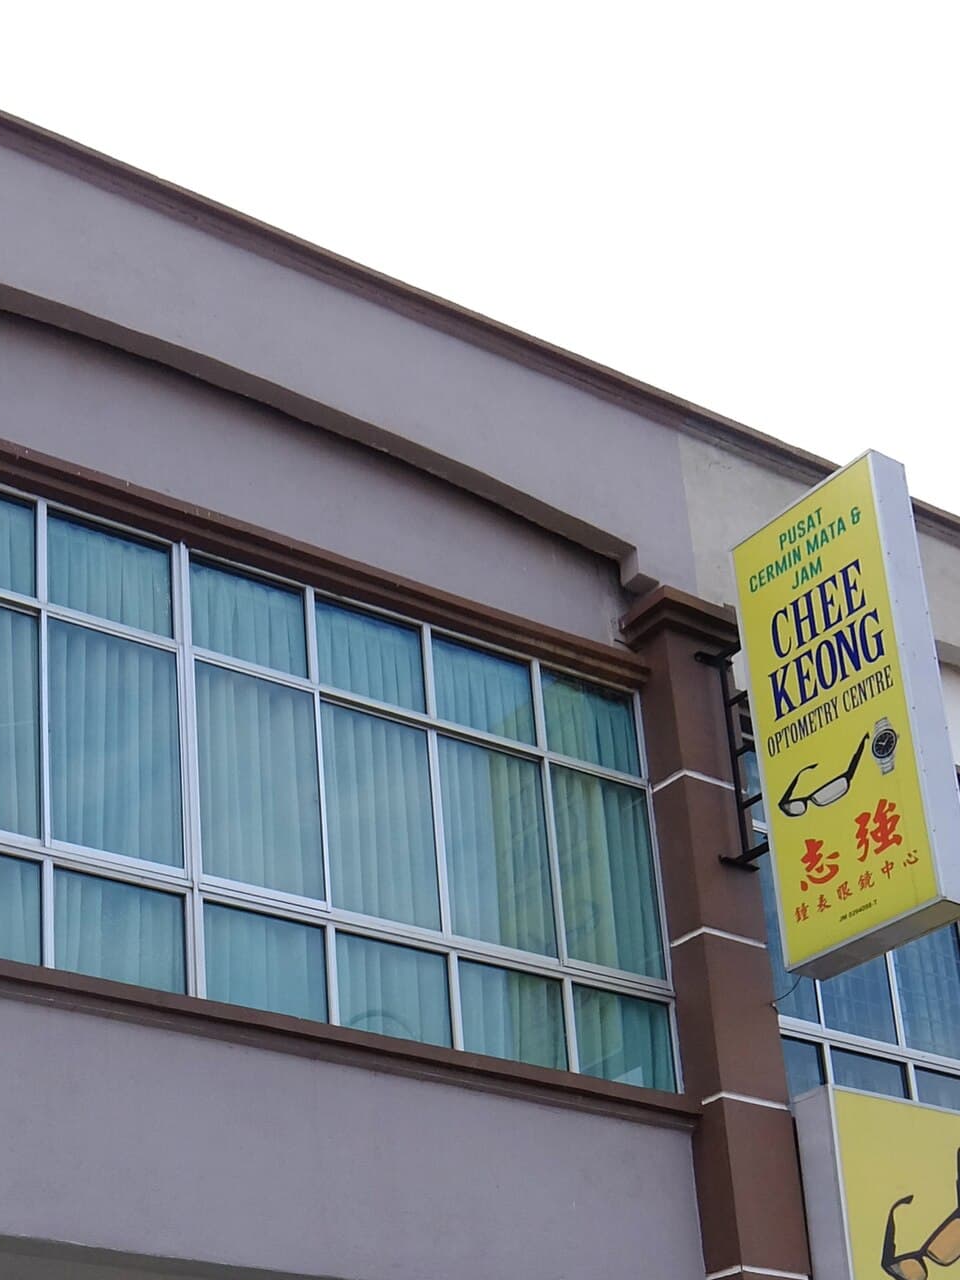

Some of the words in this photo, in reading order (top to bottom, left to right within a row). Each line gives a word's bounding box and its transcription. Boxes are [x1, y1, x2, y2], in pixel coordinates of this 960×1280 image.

[749, 546, 802, 593] CERMIN
[806, 516, 847, 556] MATA
[850, 506, 861, 525] &
[779, 507, 823, 551] PUSAT
[791, 556, 823, 590] JAM
[771, 558, 866, 659] CHEE
[768, 607, 885, 722] KEONG
[767, 696, 839, 758] OPTOMETRY
[842, 664, 894, 713] CENTRE
